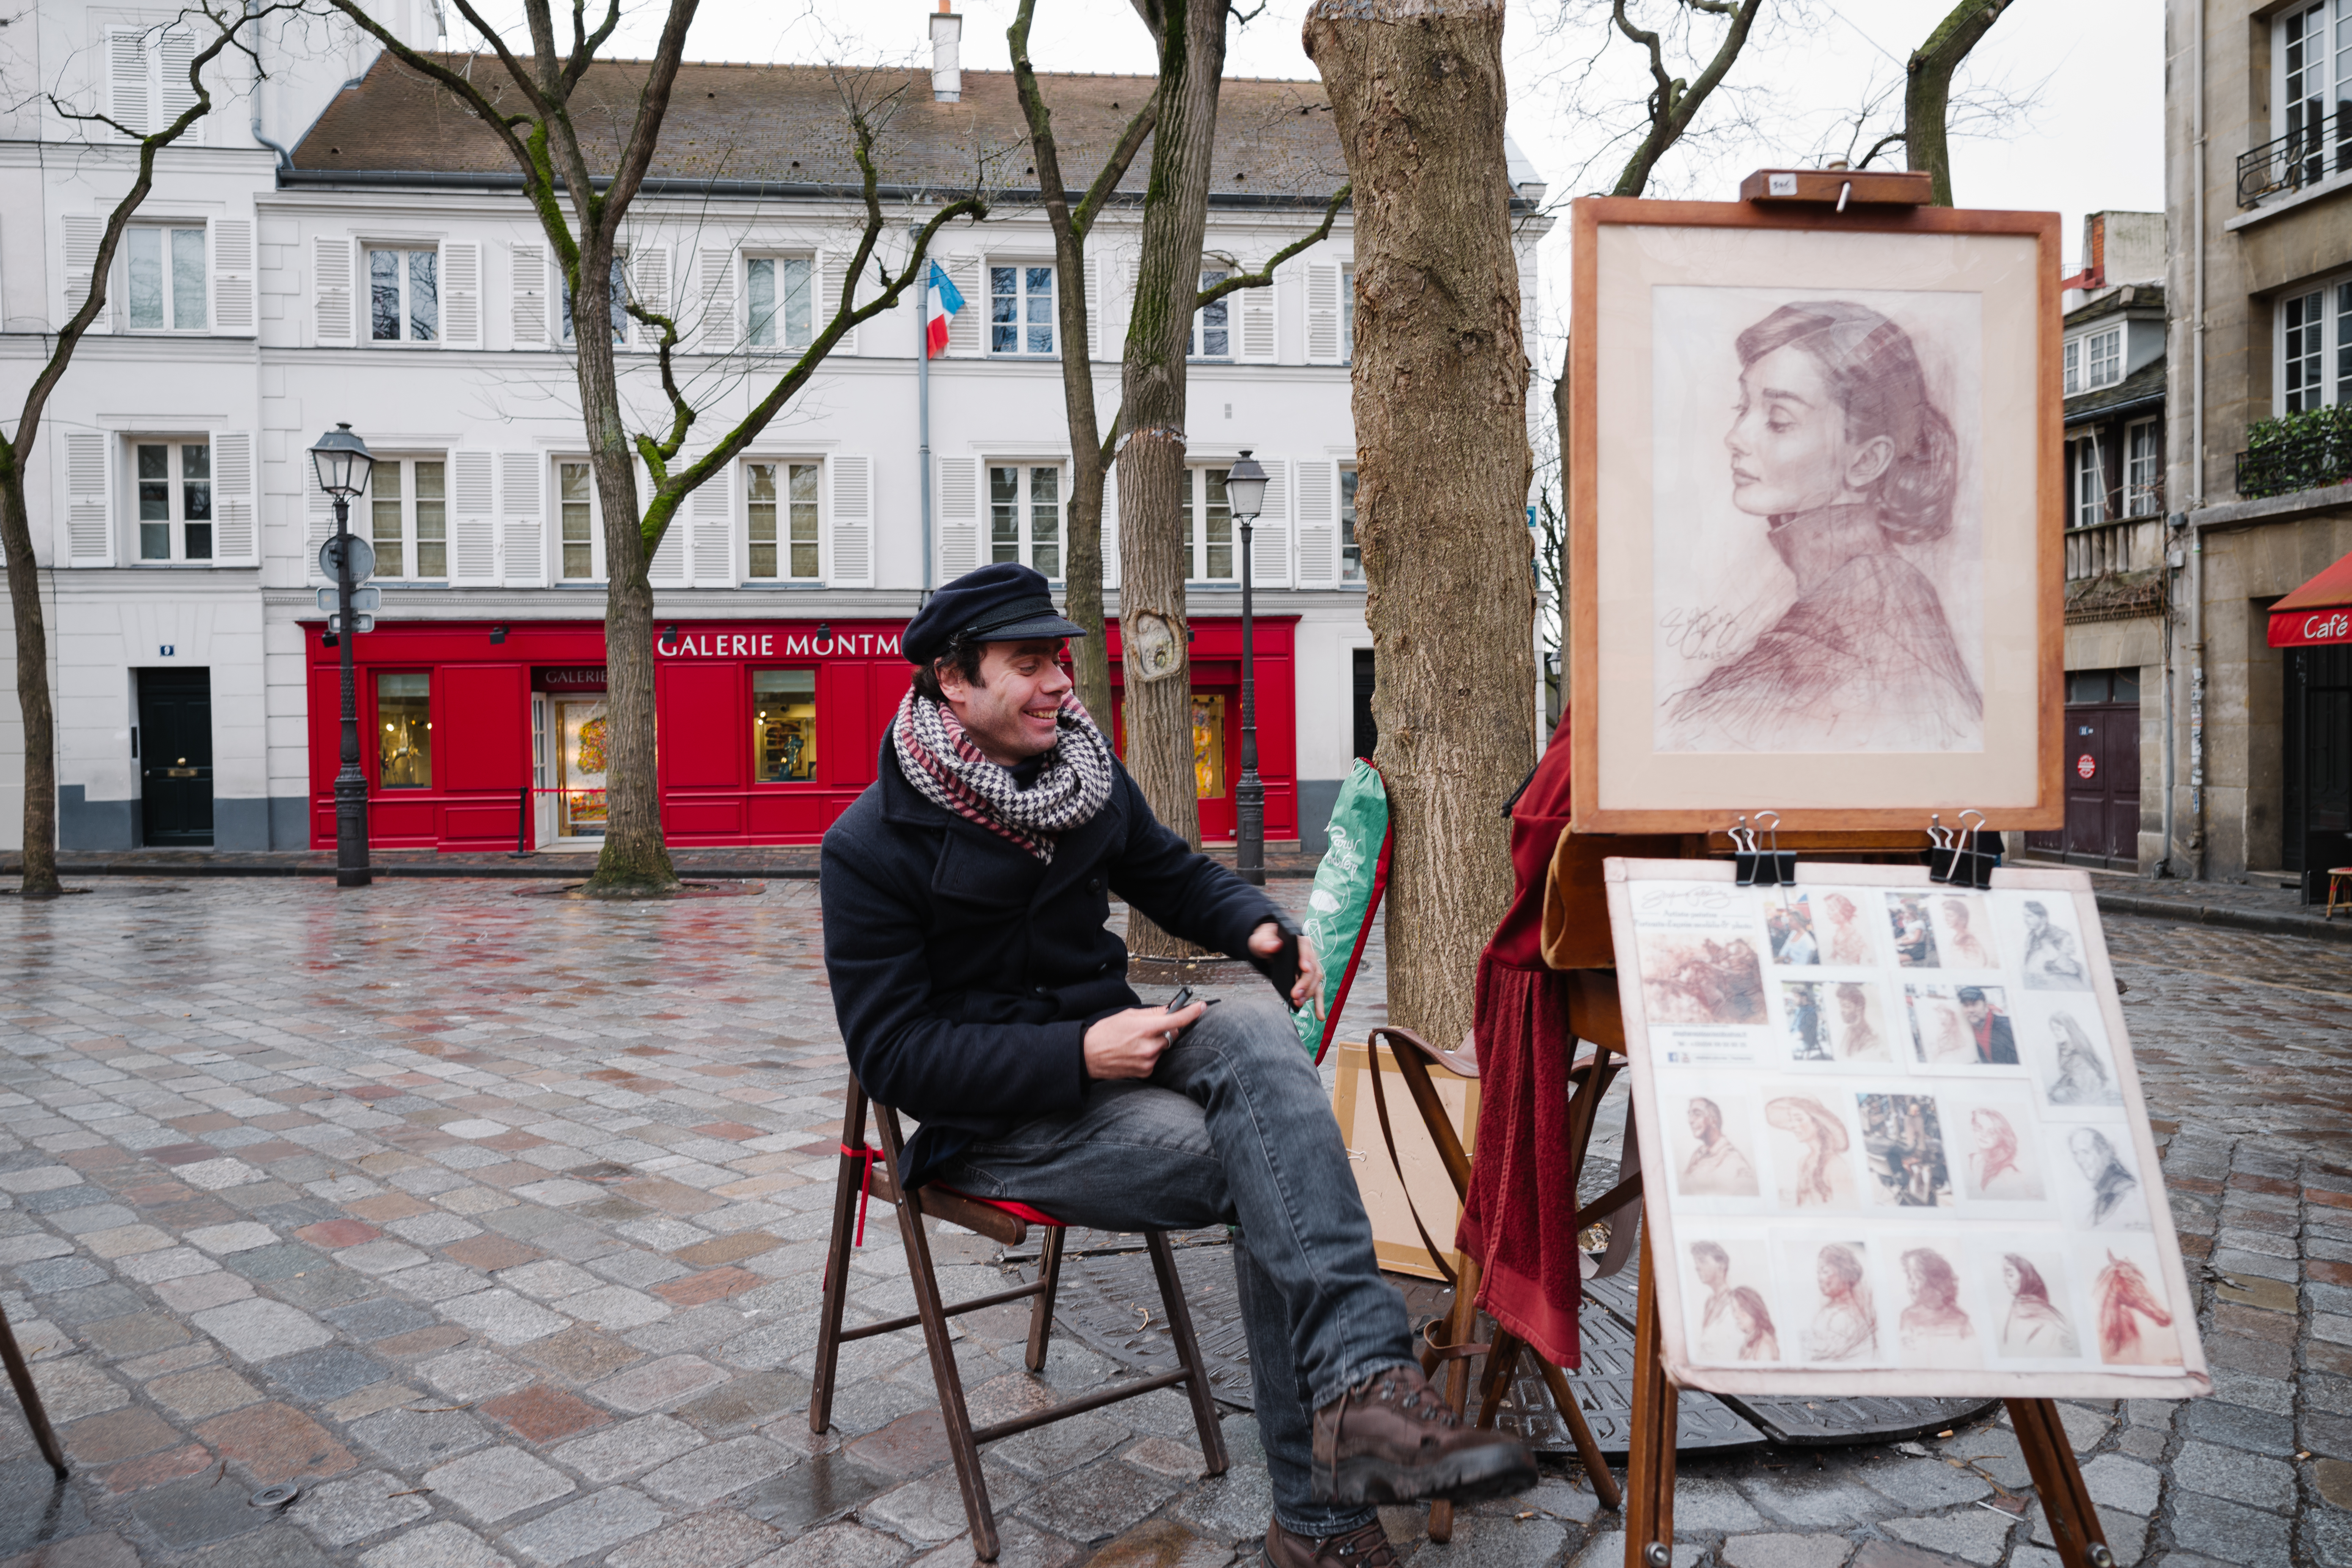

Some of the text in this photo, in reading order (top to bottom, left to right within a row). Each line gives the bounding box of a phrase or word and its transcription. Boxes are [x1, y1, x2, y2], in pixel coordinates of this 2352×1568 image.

[2304, 613, 2349, 639] Café
[164, 646, 170, 655] 9
[657, 635, 902, 657] GALERIE MONTM
[545, 670, 607, 683] GALERIE
